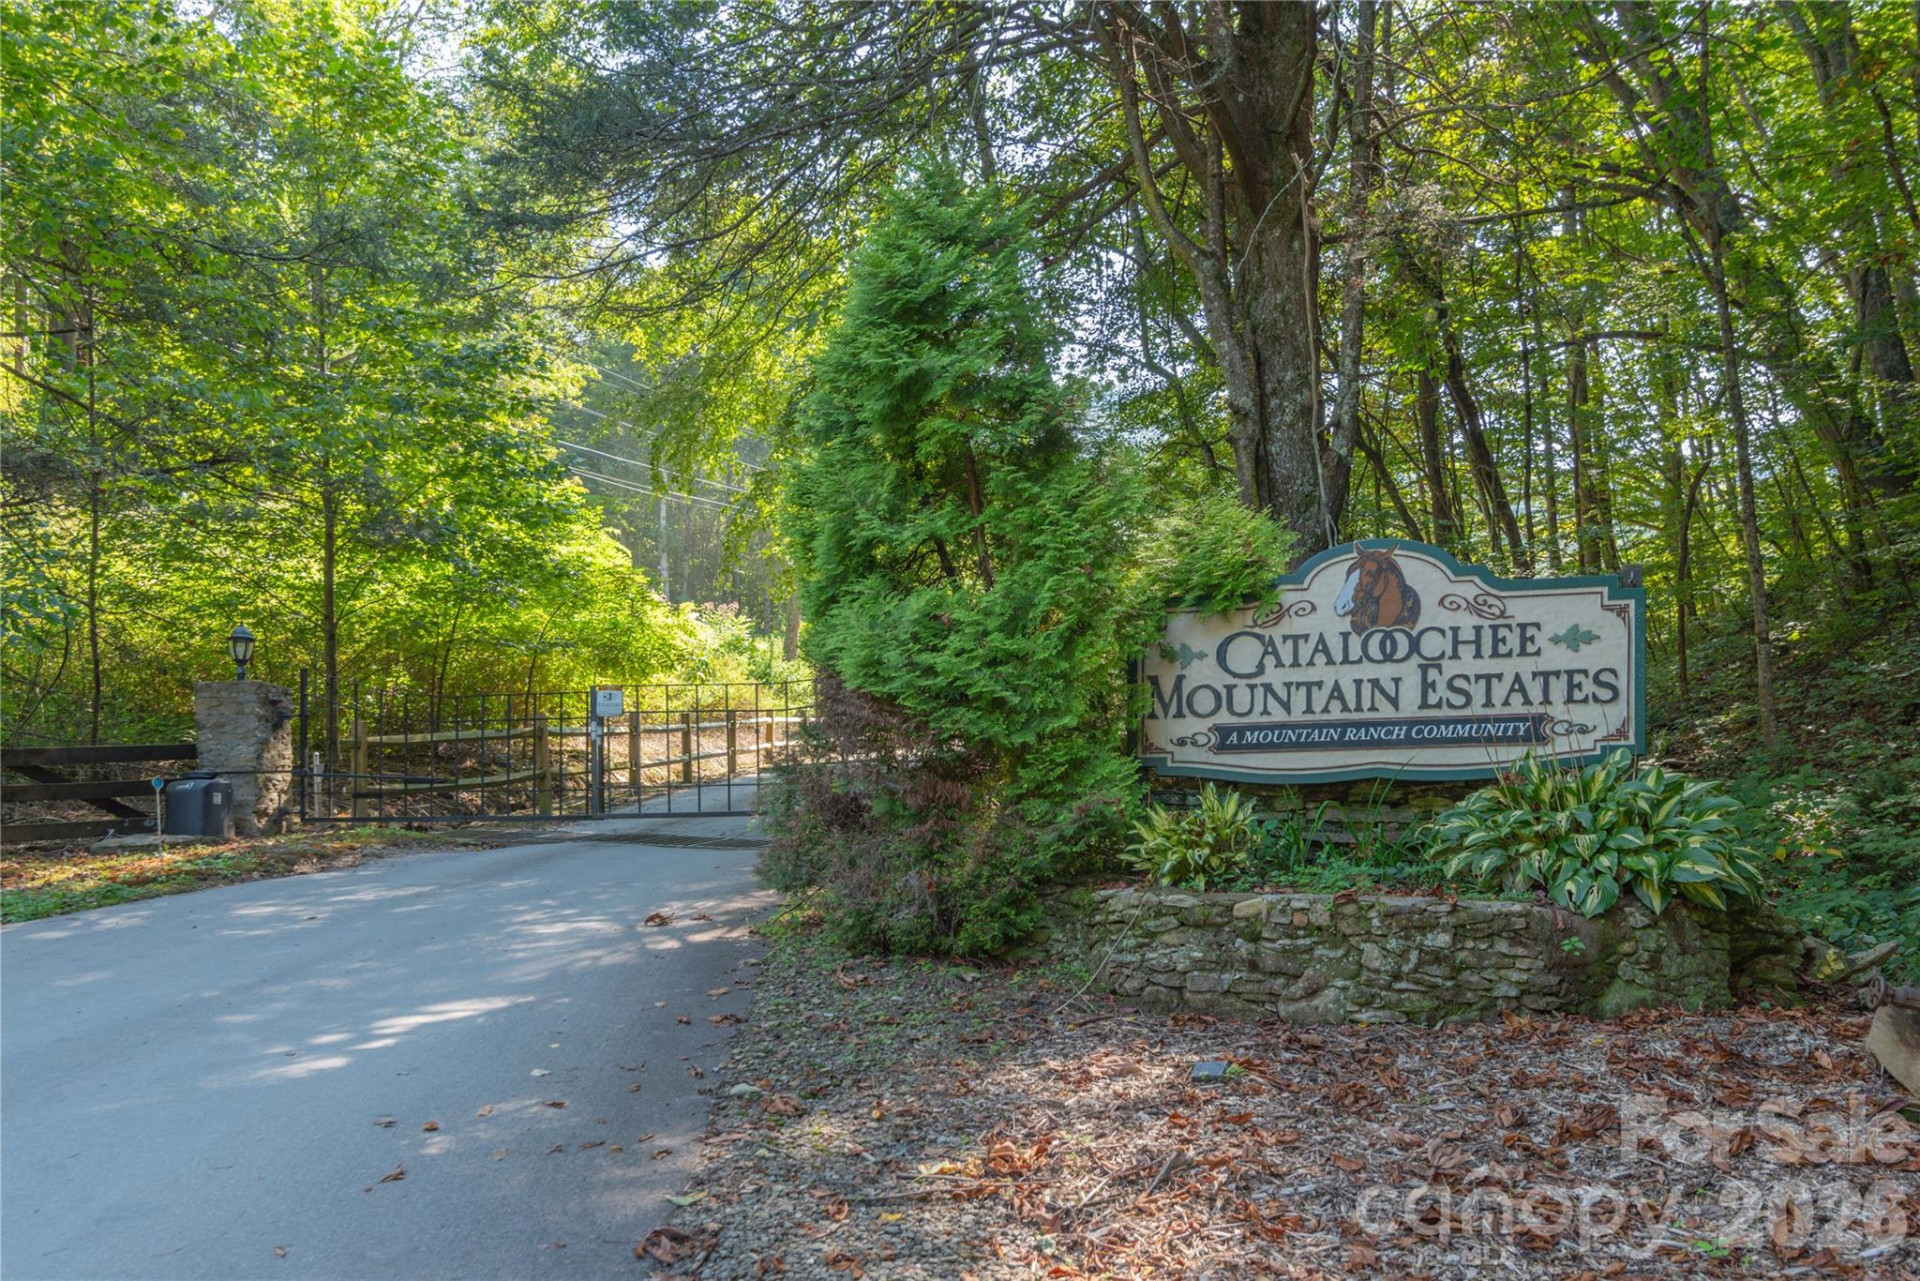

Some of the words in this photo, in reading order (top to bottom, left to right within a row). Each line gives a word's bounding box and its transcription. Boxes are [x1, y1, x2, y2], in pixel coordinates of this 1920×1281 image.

[1216, 622, 1542, 679] CATALOOCHEE
[1146, 674, 1402, 719] MOUNTAIN
[1417, 663, 1620, 710] ESTATES
[1226, 731, 1240, 744] A
[1242, 728, 1341, 745] MOUNTAIN
[1344, 725, 1406, 741] RANCH
[1411, 722, 1531, 739] COMMUNITY
